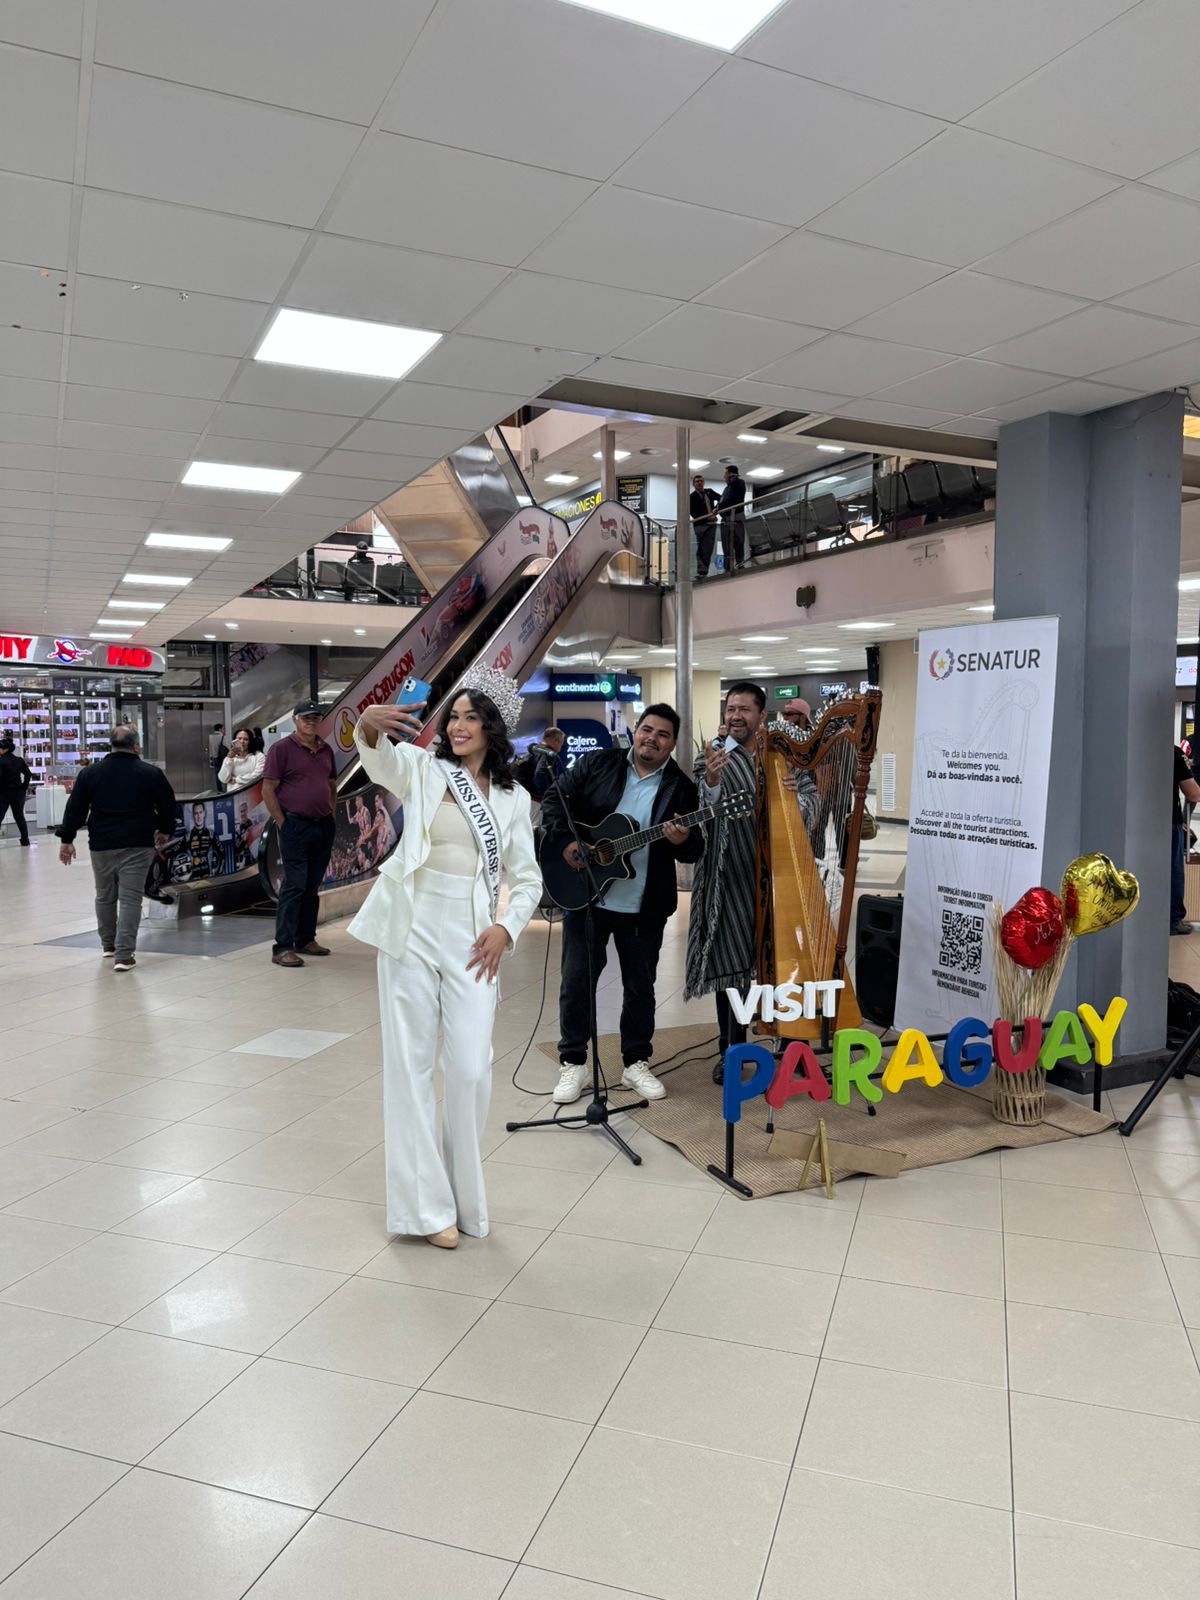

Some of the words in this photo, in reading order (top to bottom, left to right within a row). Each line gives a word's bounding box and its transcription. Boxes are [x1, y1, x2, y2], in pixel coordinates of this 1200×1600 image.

[0, 636, 33, 660] TY
[957, 648, 1041, 672] SENATUR
[555, 682, 600, 693] continental
[566, 736, 598, 748] Cajero
[942, 749, 950, 758] Te
[952, 749, 960, 759] da
[961, 750, 967, 759] la
[968, 750, 1010, 761] bienvenida.
[947, 760, 982, 770] Welcomes
[984, 763, 1001, 772] you.
[948, 771, 994, 782] boas-vindas
[1001, 775, 1023, 784] você.
[451, 770, 477, 803] MISS
[469, 803, 499, 876] UNIVERSE
[951, 811, 963, 820] toda
[964, 812, 970, 821] la
[972, 813, 993, 823] oferta
[217, 812, 233, 841] 1
[910, 826, 938, 837] Descubra
[940, 830, 957, 840] todas
[958, 833, 966, 841] as
[915, 817, 942, 827] Discover
[943, 820, 952, 829] all
[952, 821, 962, 830] the
[964, 823, 988, 833] tourist
[988, 826, 1030, 838] attractions.
[944, 895, 958, 905] TOURIST
[958, 898, 986, 910] INFORMATION
[961, 889, 972, 898] PARA
[977, 892, 993, 902] TURISTA
[932, 968, 957, 982] INFORMACIÓN
[957, 976, 968, 986] PARA
[969, 979, 987, 992] TURISTAS
[726, 979, 845, 1025] VISIT
[723, 997, 1128, 1123] PARAGUAY
